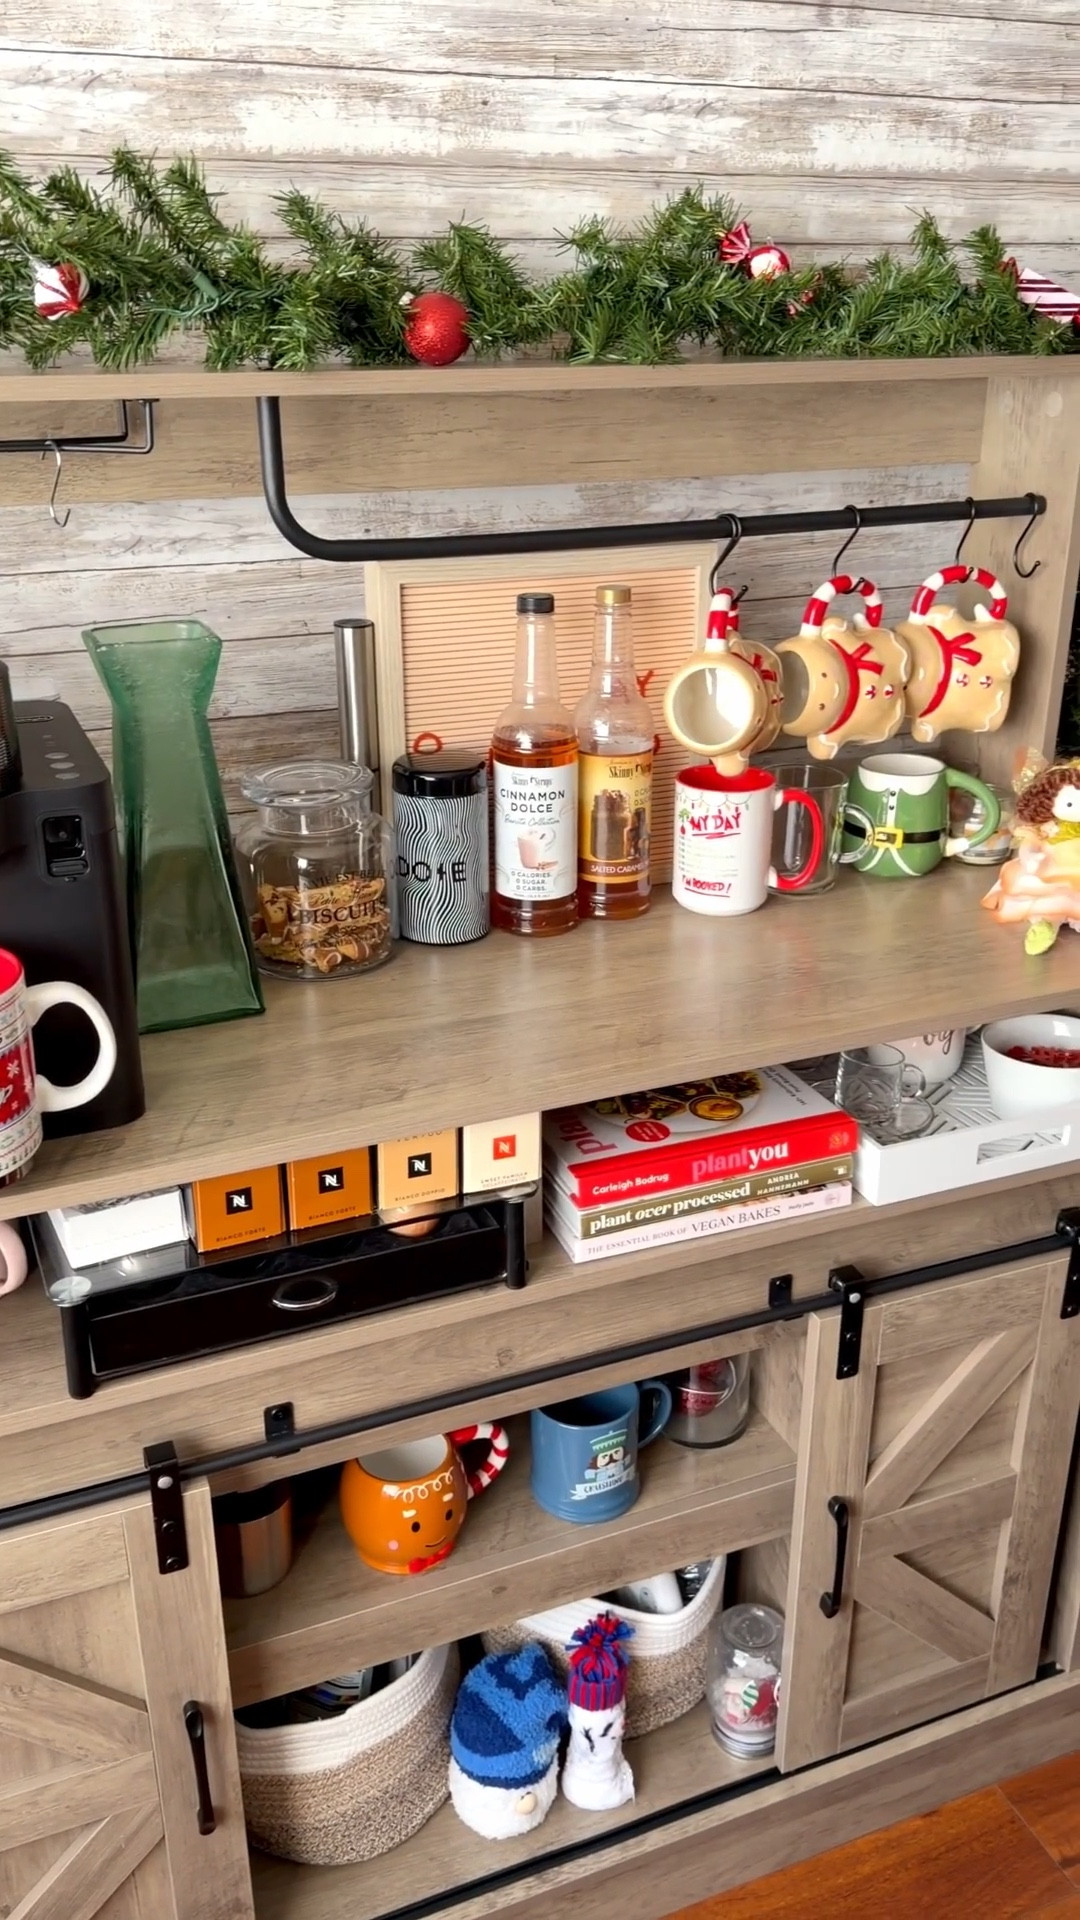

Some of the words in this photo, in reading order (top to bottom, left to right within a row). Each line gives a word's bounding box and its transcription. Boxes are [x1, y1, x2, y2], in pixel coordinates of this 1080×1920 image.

[500, 788, 565, 801] CINNAMON
[511, 802, 553, 813] DOLCE
[688, 815, 709, 831] MY
[711, 812, 741, 831] DAY
[591, 865, 616, 874] SALTED
[592, 1181, 634, 1195] Carleigh
[635, 1173, 670, 1188] Bodrug
[767, 1172, 800, 1185] ANDREA
[590, 1213, 633, 1235] plant
[634, 1204, 672, 1221] over
[673, 1182, 751, 1215] processed
[606, 1234, 651, 1251] ESSENTIAL
[652, 1229, 675, 1241] BOOK
[691, 1214, 736, 1234] VEGAN
[738, 1205, 781, 1224] BAKES
